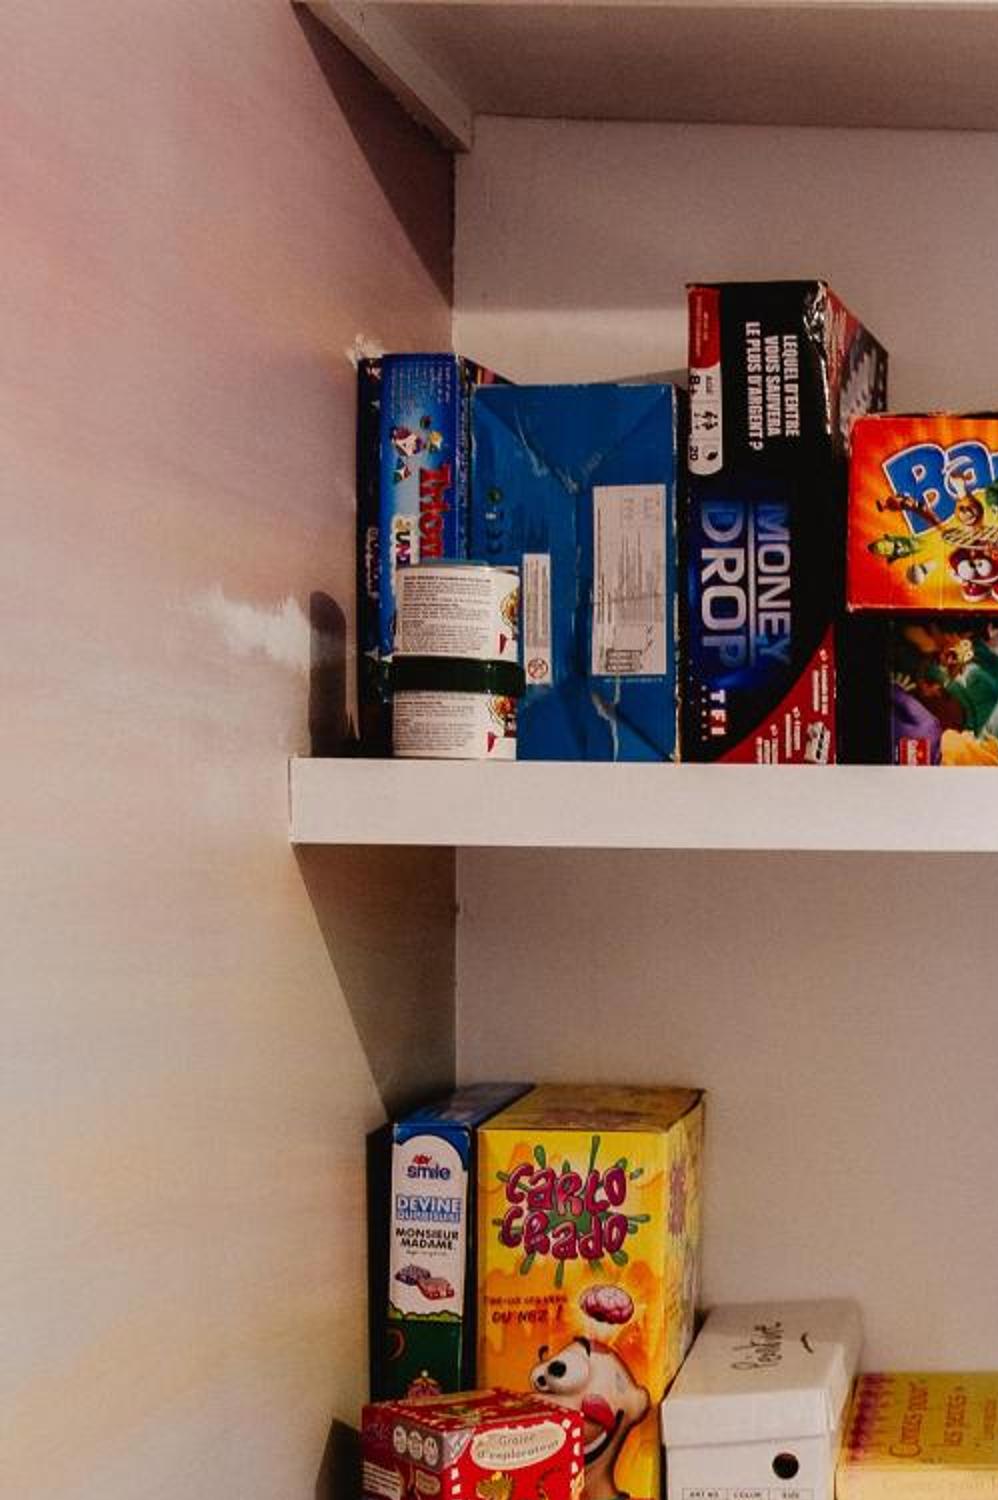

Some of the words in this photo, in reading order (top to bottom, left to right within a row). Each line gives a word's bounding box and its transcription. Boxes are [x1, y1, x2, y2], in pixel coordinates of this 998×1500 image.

[745, 321, 761, 336] LE
[746, 338, 762, 372] PLUS
[764, 336, 780, 373] VOUS
[782, 335, 799, 380] LEQUEL
[748, 375, 763, 438] D'ARGENT
[765, 375, 781, 437] SAUVERA
[784, 384, 800, 437] D'ENTRE
[701, 508, 747, 667] DROP
[757, 504, 791, 664] MONEY
[407, 1164, 450, 1180] smile
[397, 1195, 461, 1213] DEVINE
[396, 1227, 459, 1240] MONSIEUR
[401, 1238, 453, 1250] MADAME
[518, 1310, 548, 1324] NEZ
